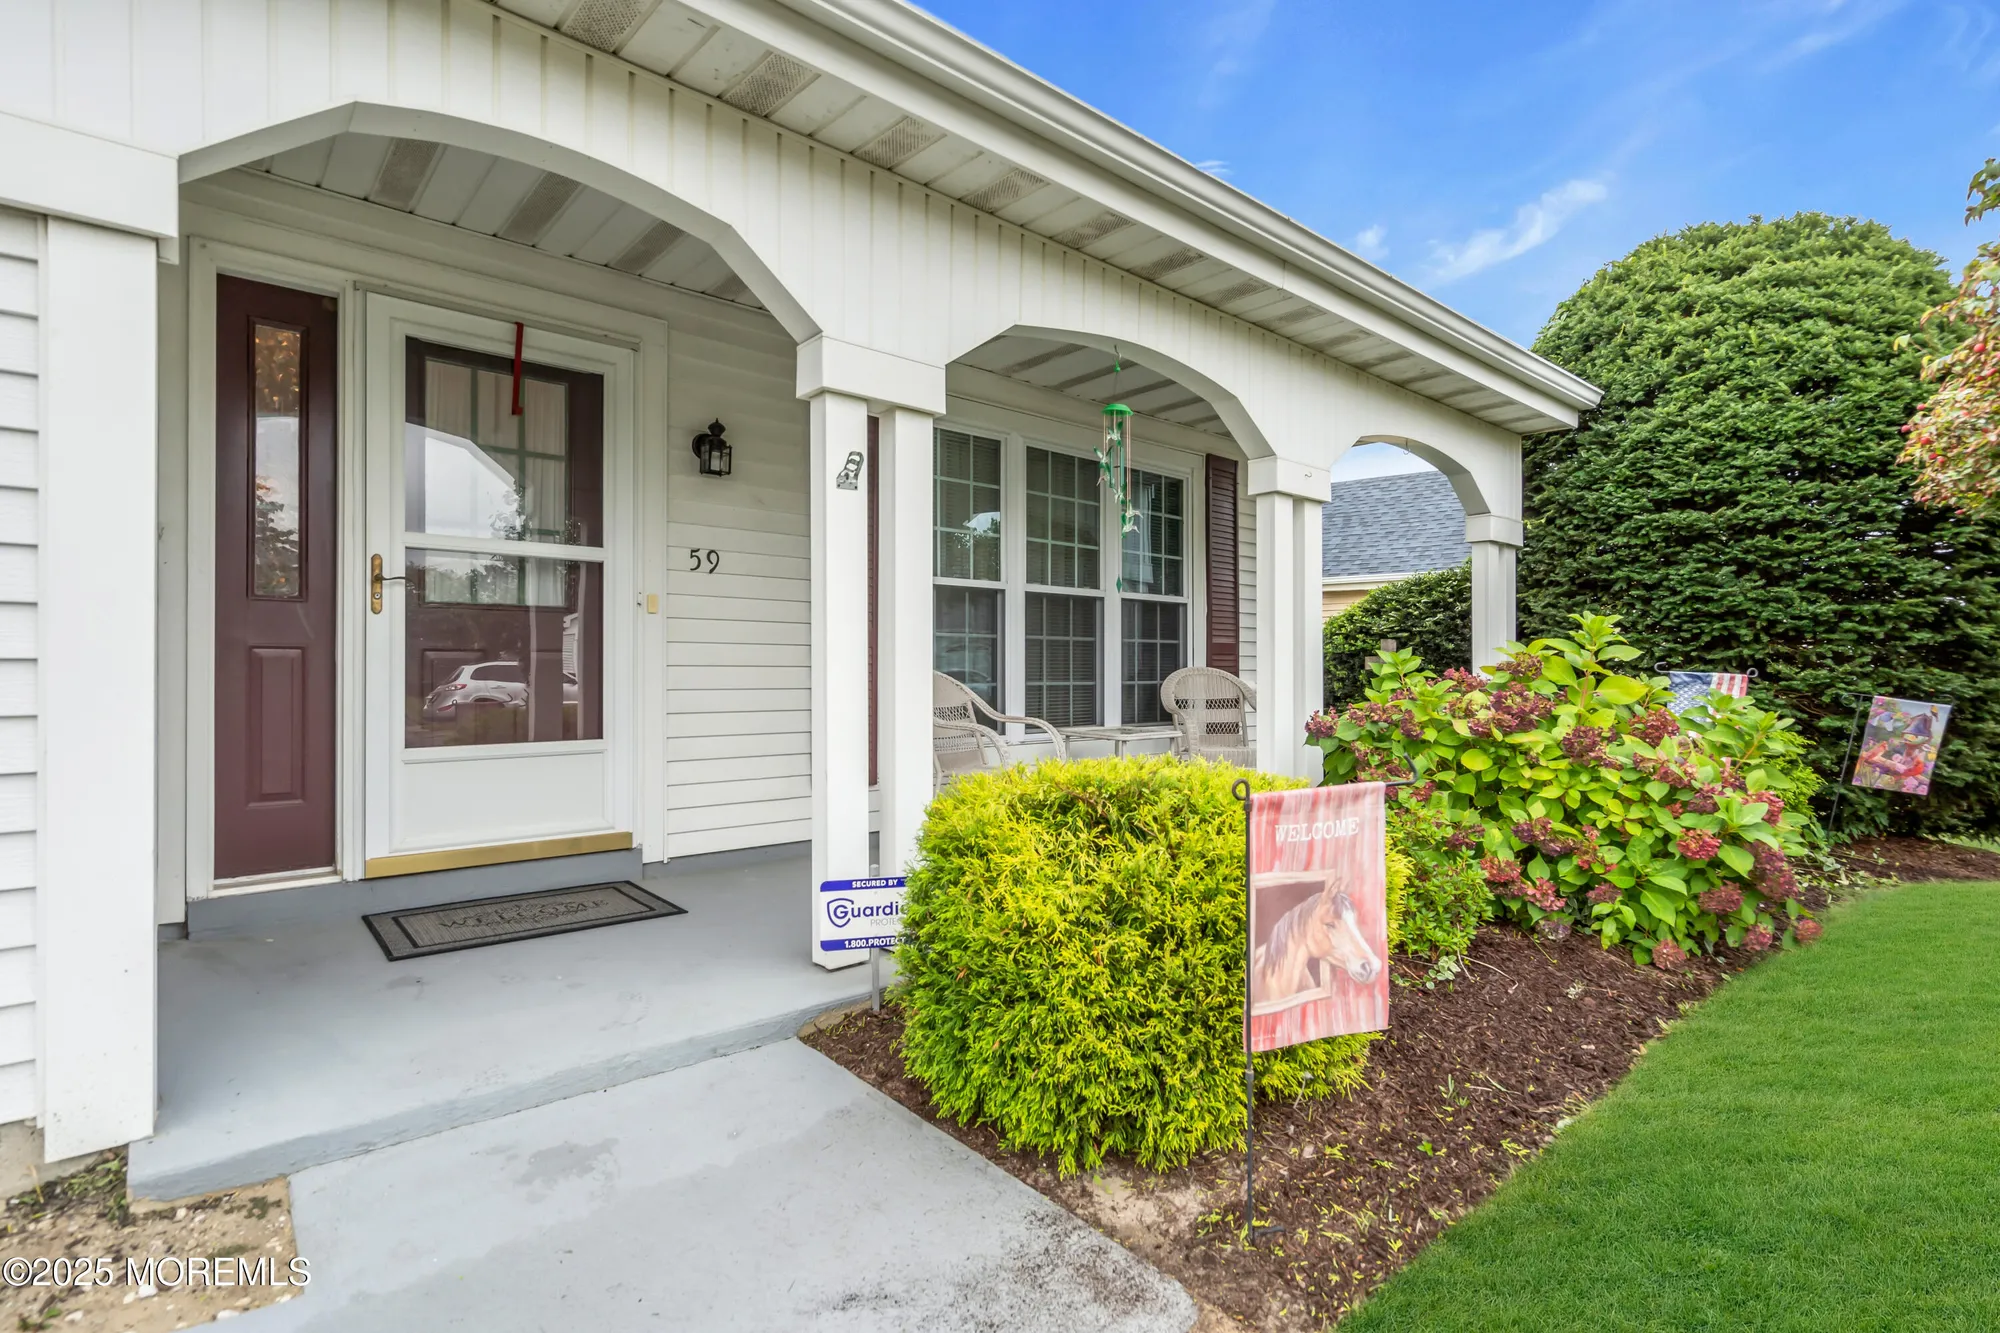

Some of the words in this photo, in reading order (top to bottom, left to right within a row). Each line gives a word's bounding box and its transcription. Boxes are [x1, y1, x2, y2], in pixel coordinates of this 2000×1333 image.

[690, 548, 720, 574] 59
[1275, 817, 1359, 843] WELCOME
[852, 879, 887, 888] SECURED
